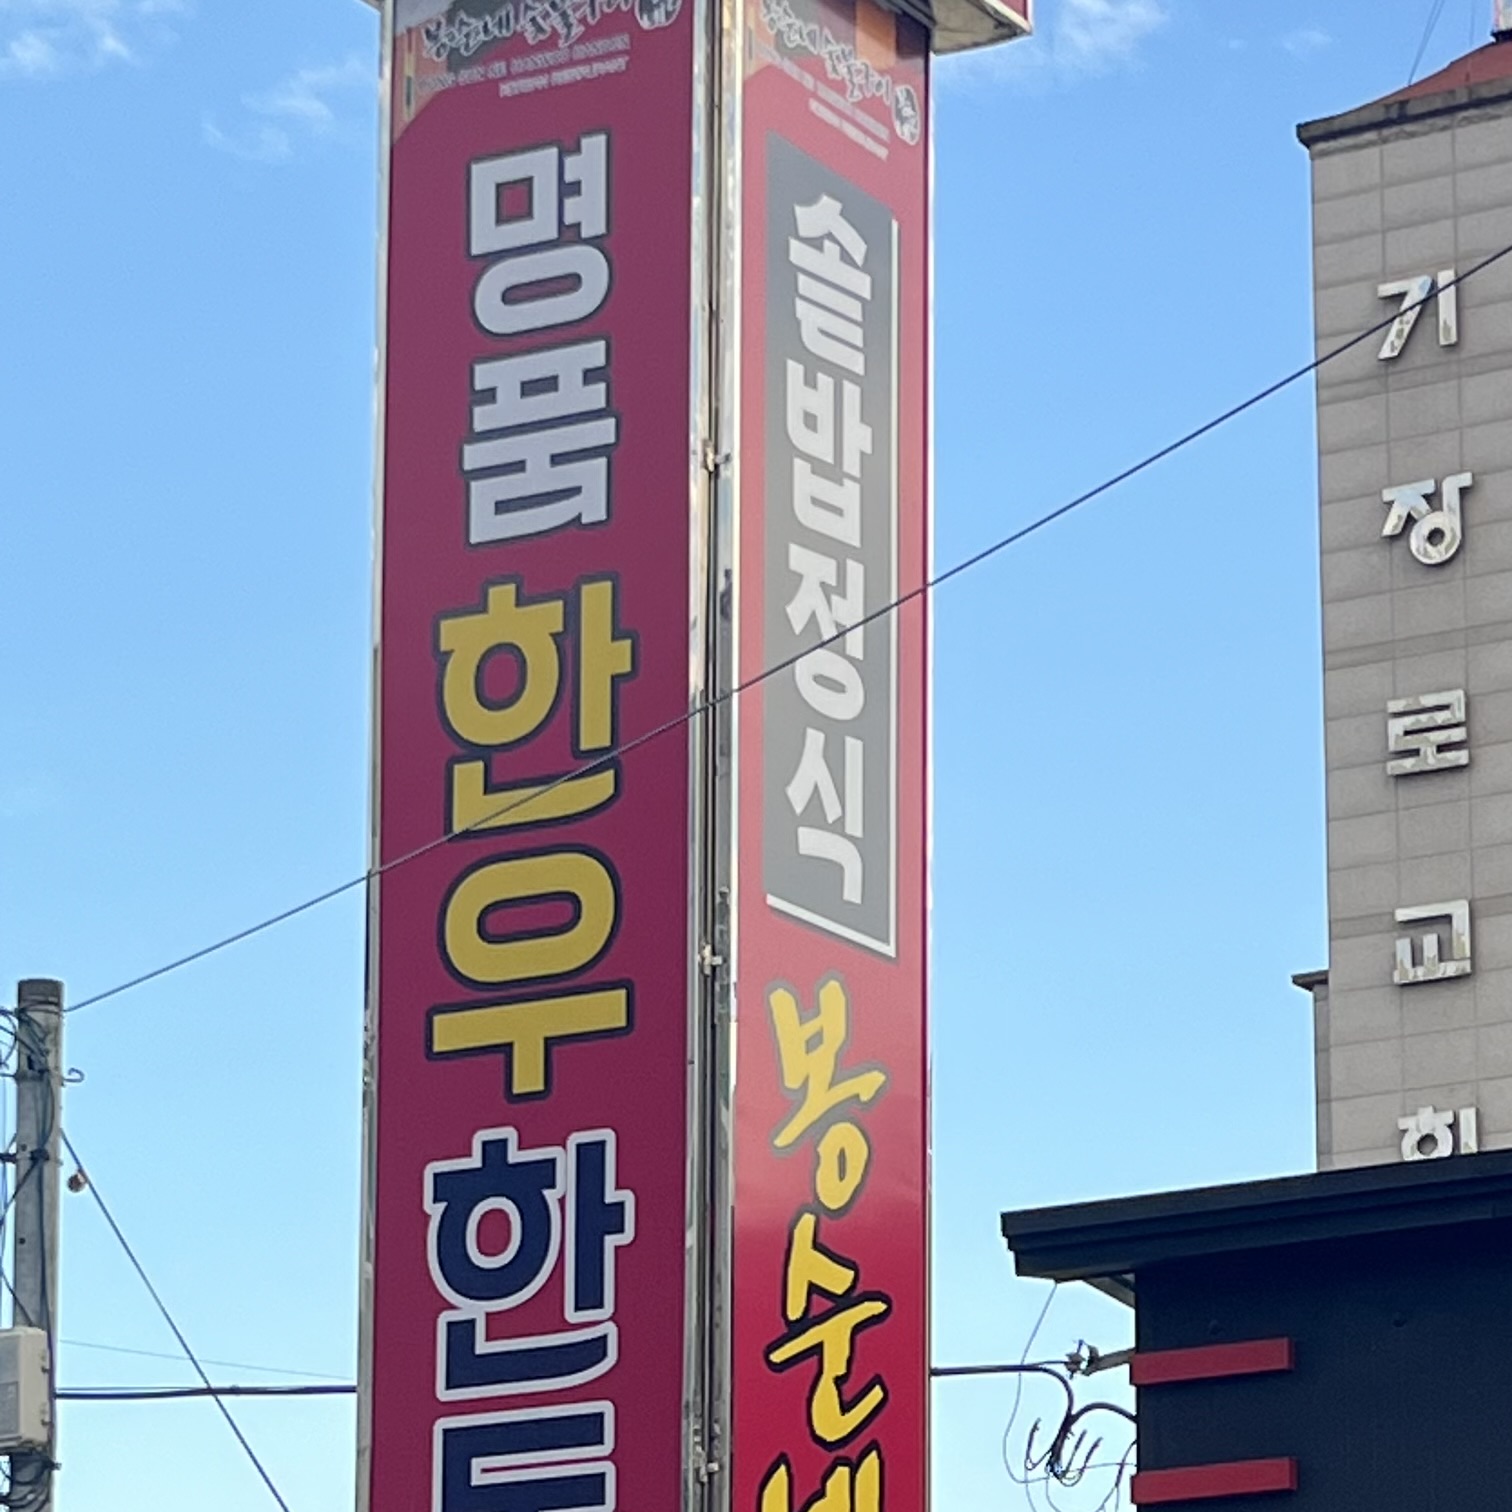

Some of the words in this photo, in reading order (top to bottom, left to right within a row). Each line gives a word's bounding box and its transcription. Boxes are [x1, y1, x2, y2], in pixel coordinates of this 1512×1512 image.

[462, 130, 618, 548] 명품
[785, 192, 873, 906] 솥밥정식
[425, 575, 635, 1103] 한우
